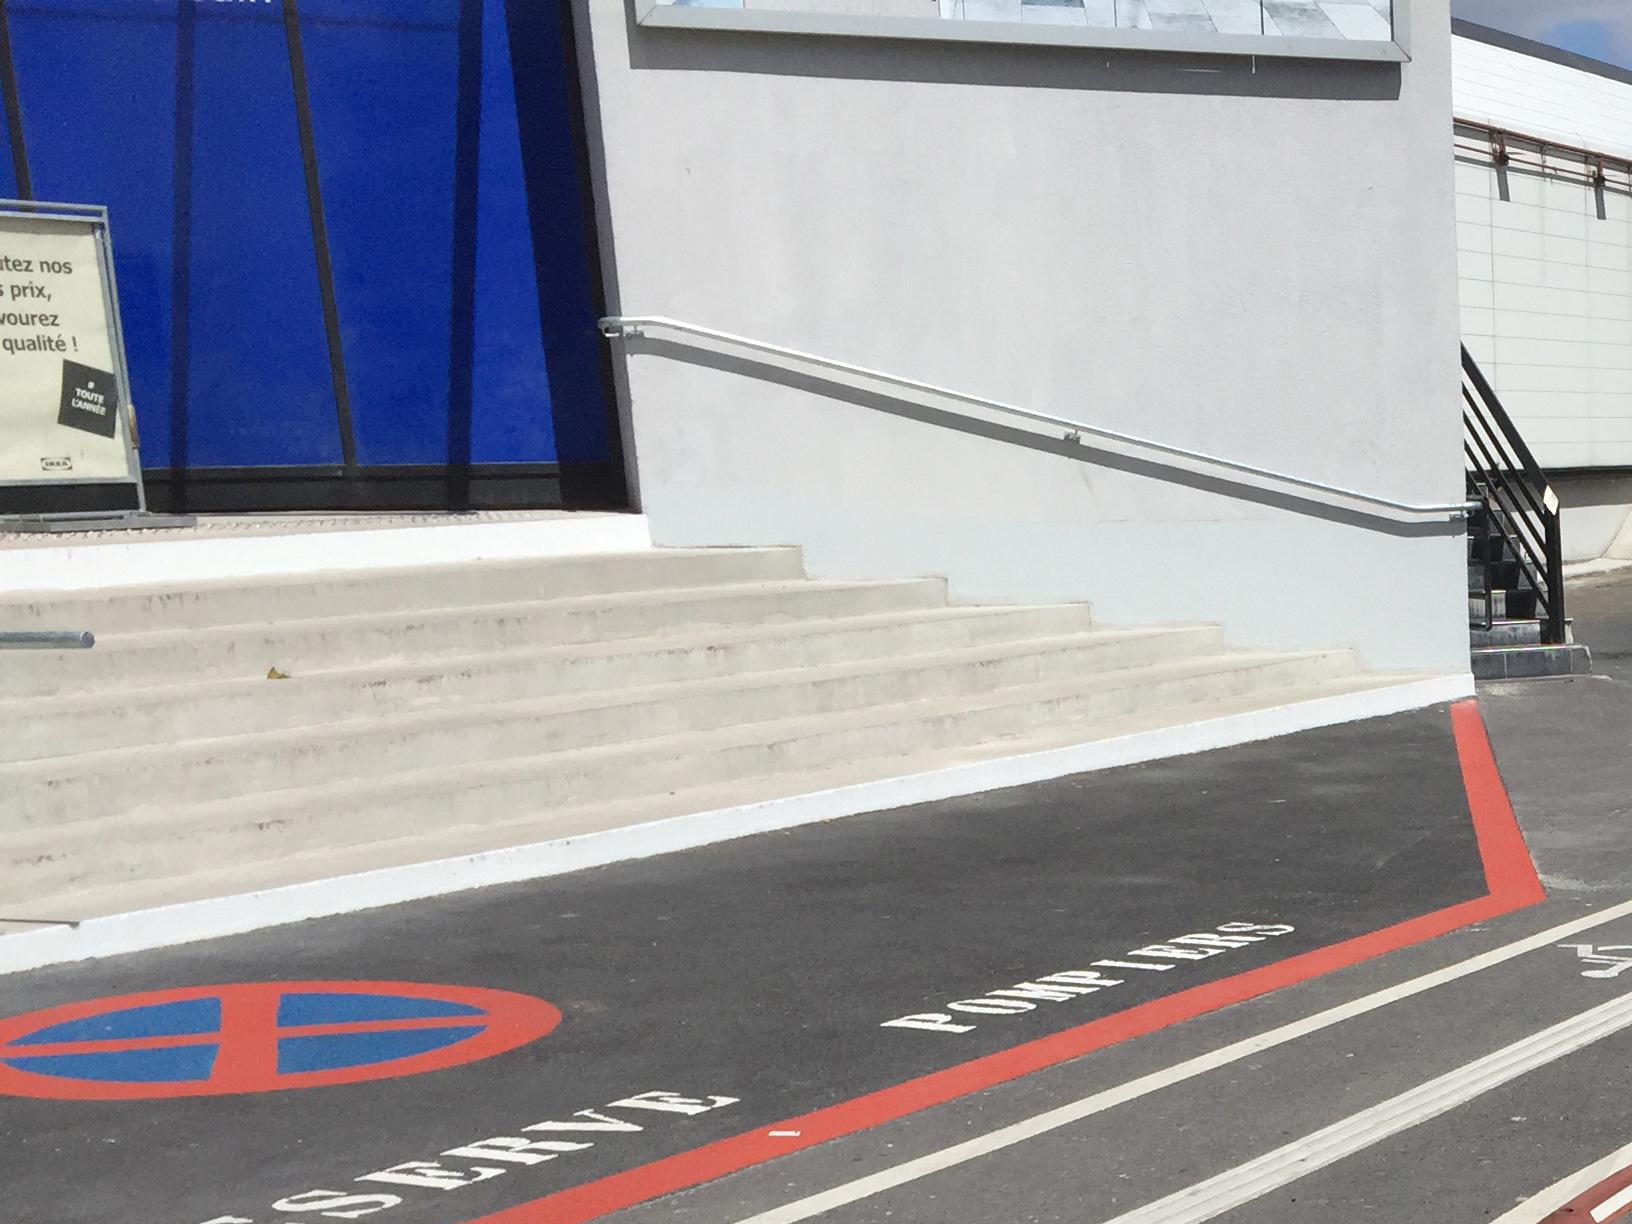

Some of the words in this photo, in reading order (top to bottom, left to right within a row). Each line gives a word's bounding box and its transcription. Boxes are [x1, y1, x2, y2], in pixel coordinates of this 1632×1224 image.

[40, 261, 73, 274] nos
[10, 281, 51, 302] prix,
[2, 334, 67, 355] qualité
[75, 387, 104, 404] TOUTE
[880, 922, 1295, 1034] POMPIERS
